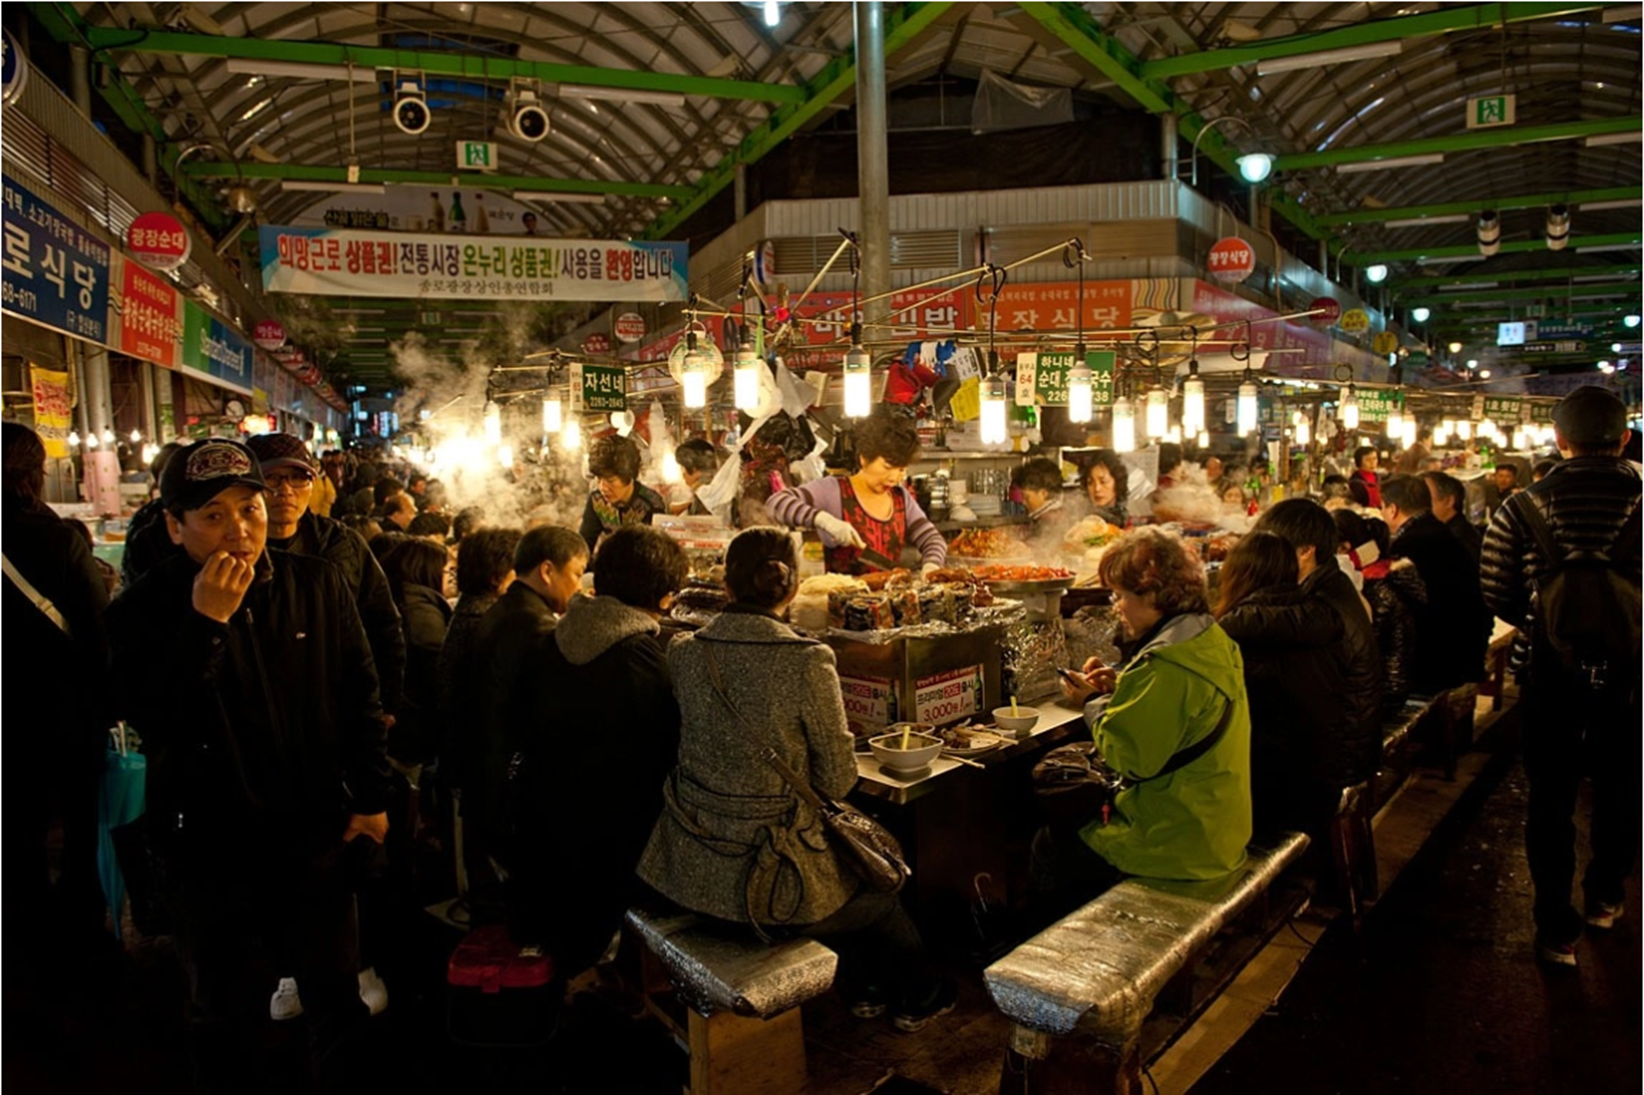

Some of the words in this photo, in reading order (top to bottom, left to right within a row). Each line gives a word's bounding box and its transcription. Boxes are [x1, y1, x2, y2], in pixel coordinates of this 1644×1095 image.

[131, 227, 185, 250] 광장순대
[277, 233, 341, 271] 희망근로
[345, 240, 398, 275] 상품권!
[463, 244, 507, 277] 온누리
[510, 246, 560, 279] 상품권!
[561, 247, 602, 280] 사용을
[605, 247, 673, 281] 환영합니다
[1041, 355, 1075, 368] 하니네
[585, 372, 624, 394] 자선네
[1019, 374, 1033, 384] 64
[917, 688, 943, 705] 프리미엄
